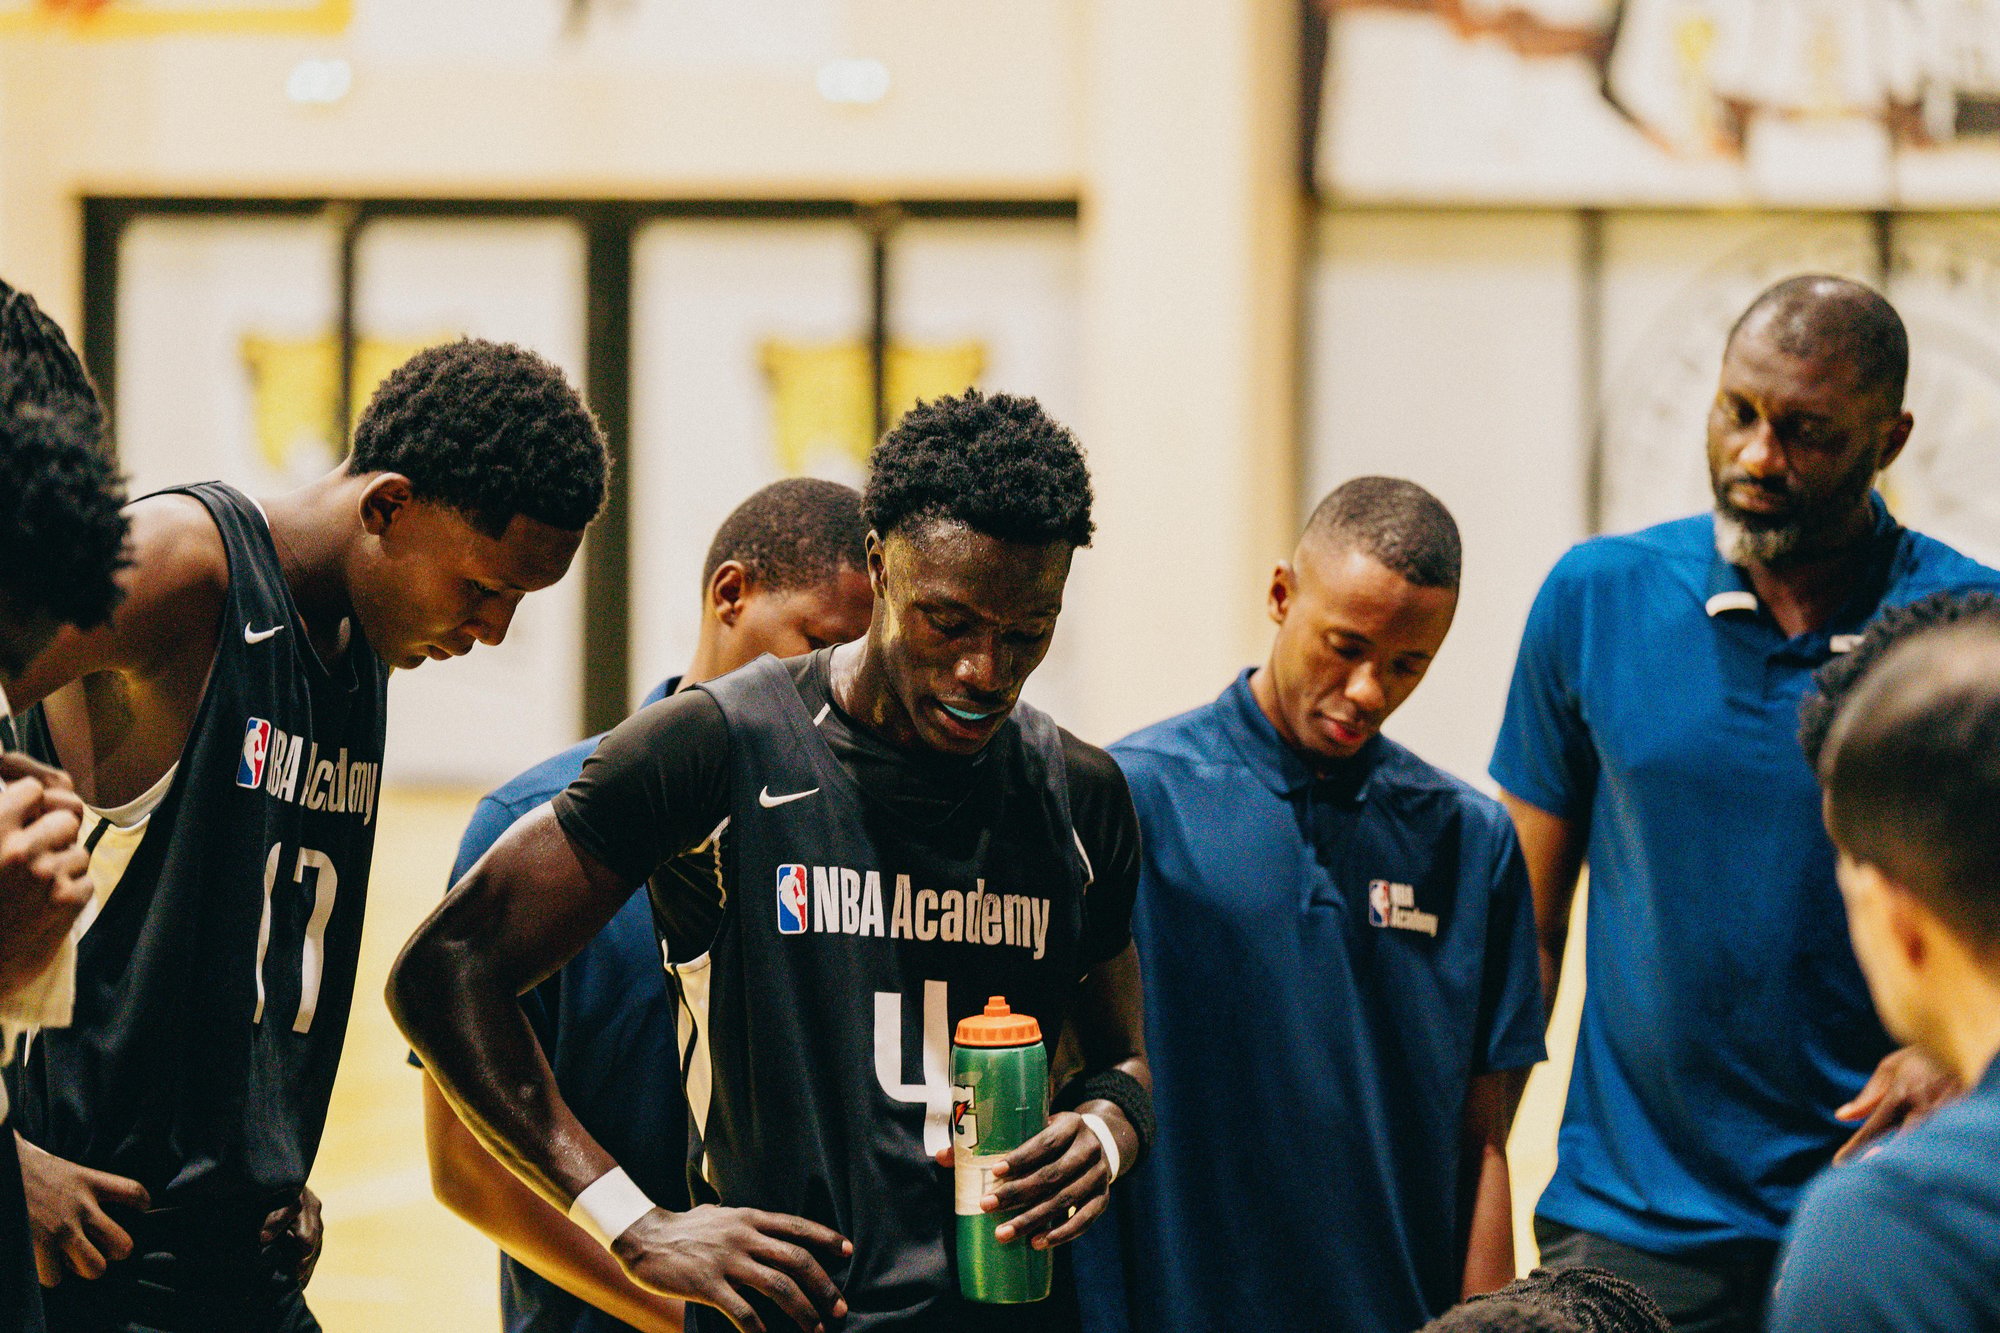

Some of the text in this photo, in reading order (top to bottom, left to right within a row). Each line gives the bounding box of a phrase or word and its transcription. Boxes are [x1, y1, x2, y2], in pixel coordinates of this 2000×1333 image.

[266, 727, 304, 803] BA
[253, 842, 338, 1033] 17
[813, 866, 1050, 960] NBA Academy
[874, 980, 953, 1157] 4
